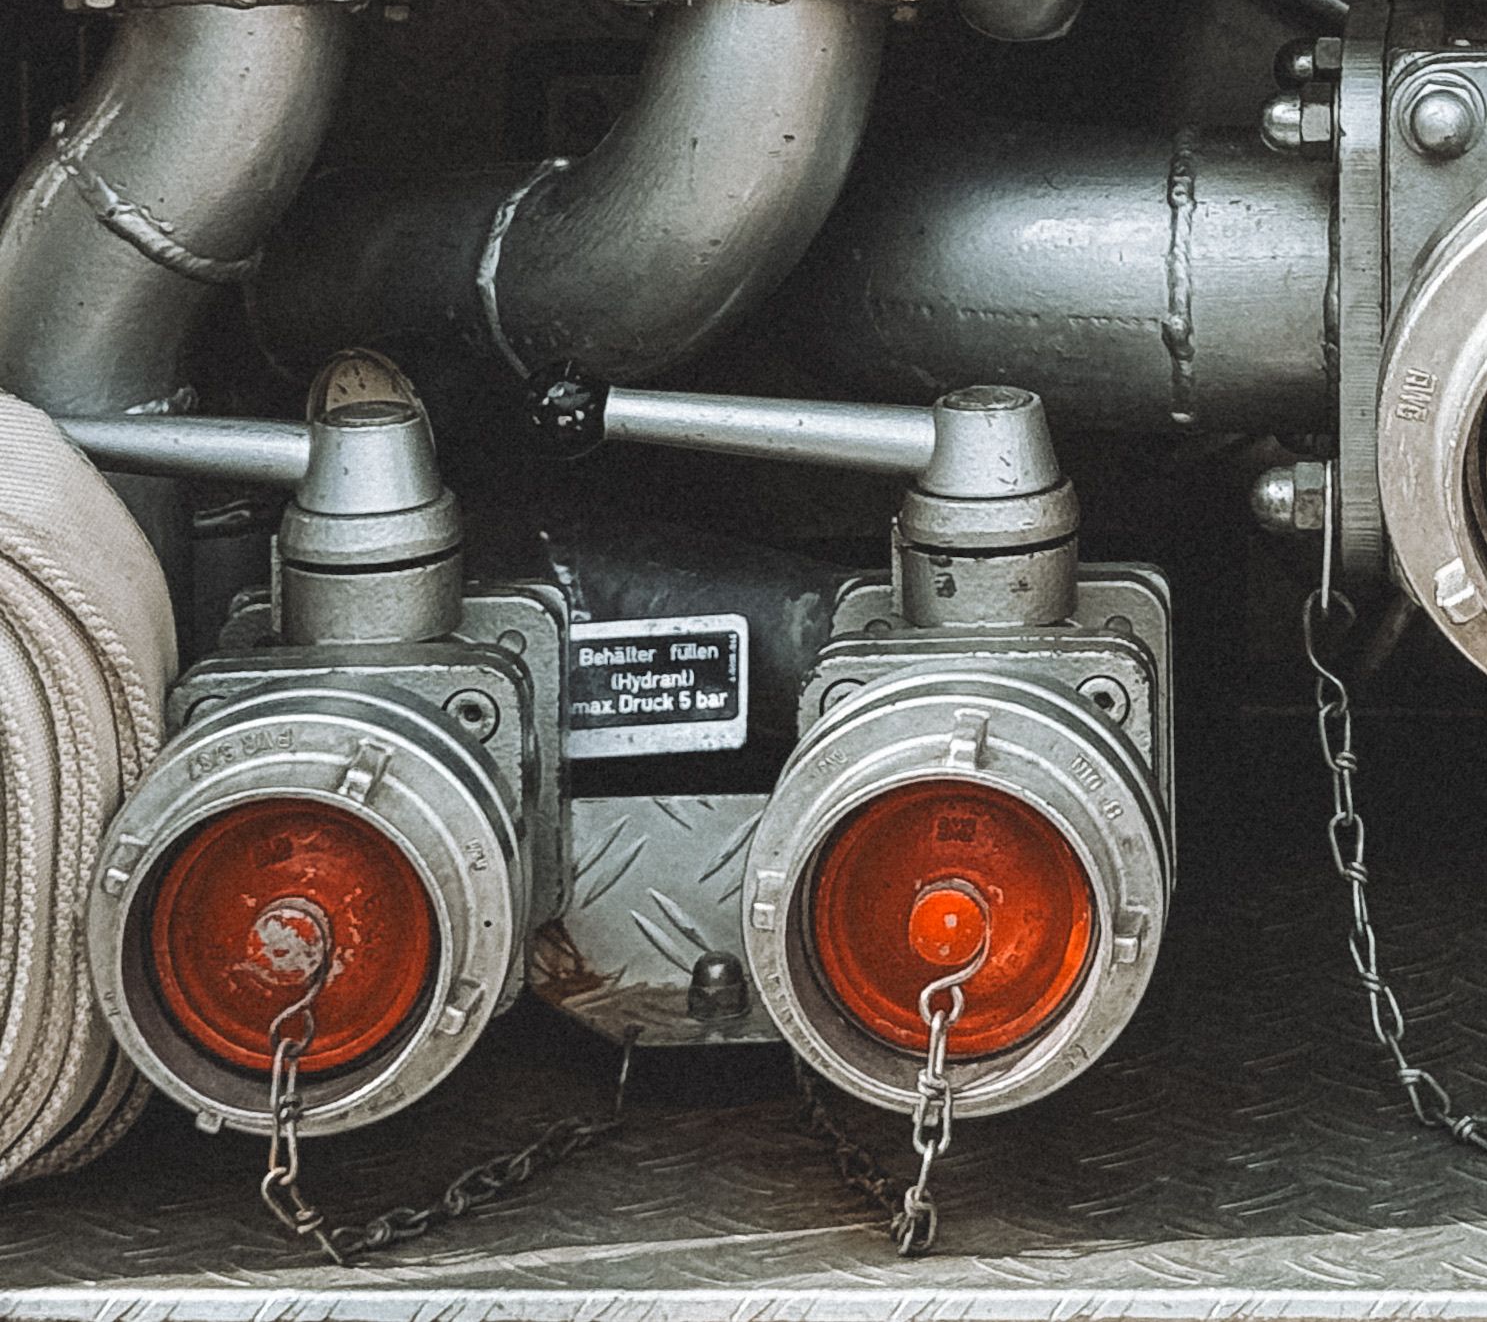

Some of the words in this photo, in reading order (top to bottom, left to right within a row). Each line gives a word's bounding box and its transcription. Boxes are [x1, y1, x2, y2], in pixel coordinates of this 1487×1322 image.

[579, 645, 657, 667] Behälter
[670, 642, 720, 661] füllen
[571, 698, 616, 716] max.
[618, 692, 674, 714] Druck
[678, 691, 692, 710] 5
[695, 689, 728, 708] bar
